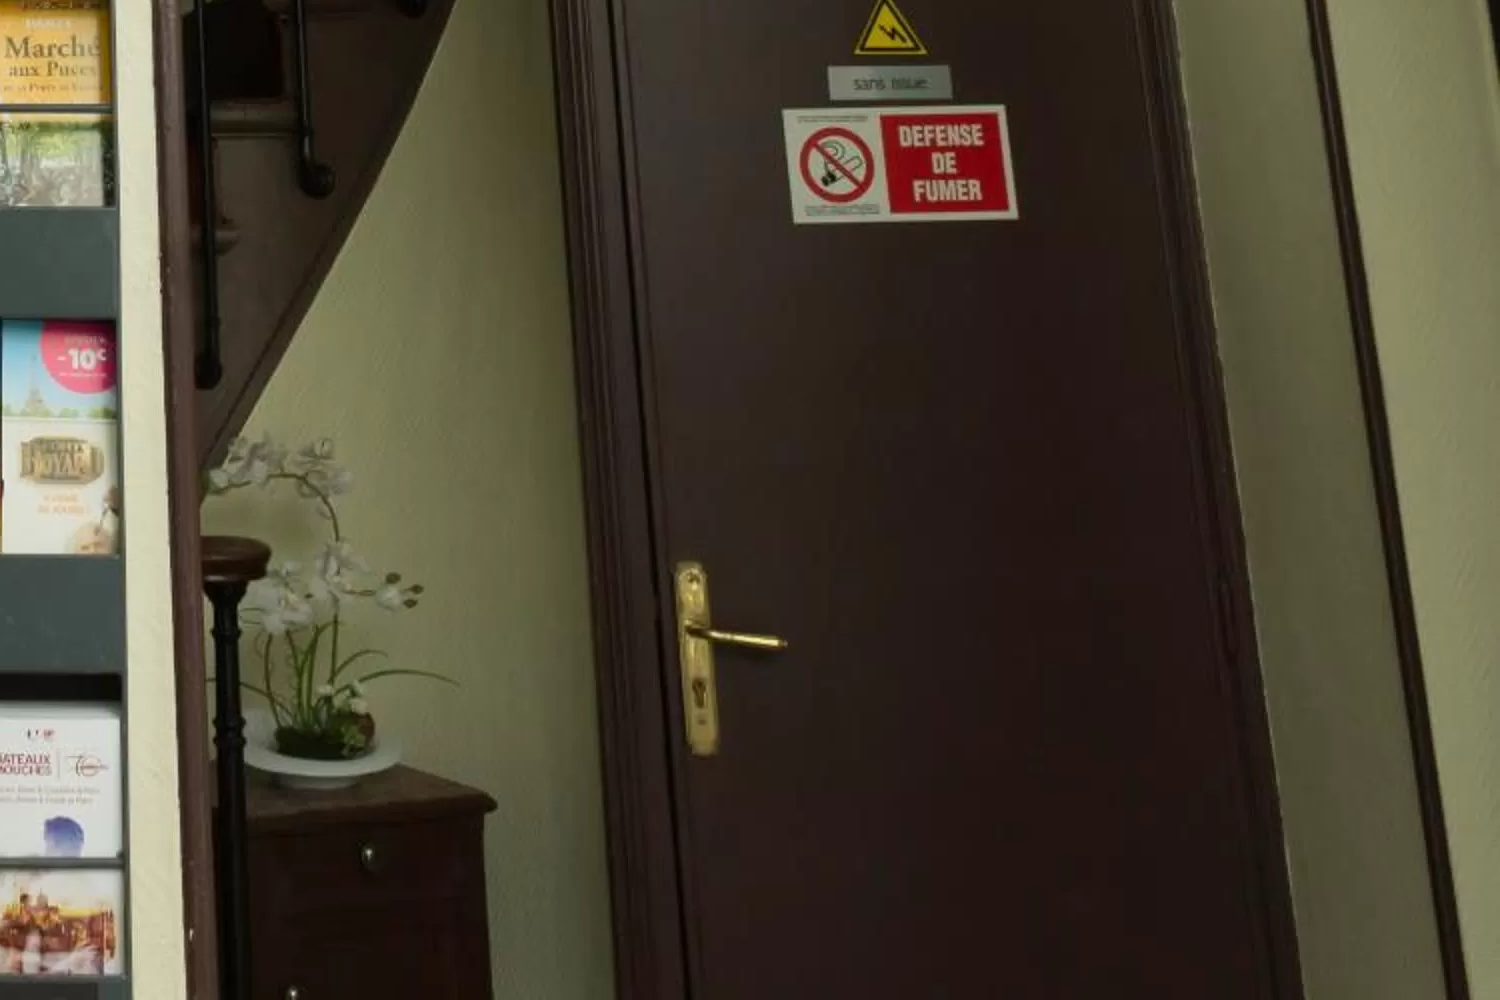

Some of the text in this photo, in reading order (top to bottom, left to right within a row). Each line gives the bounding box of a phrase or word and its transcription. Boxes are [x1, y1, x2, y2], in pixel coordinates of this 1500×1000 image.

[9, 61, 97, 77] aux Puces
[853, 77, 886, 91] sans
[897, 123, 985, 148] DEFENSE
[931, 152, 957, 174] DE
[912, 179, 983, 203] FUMER
